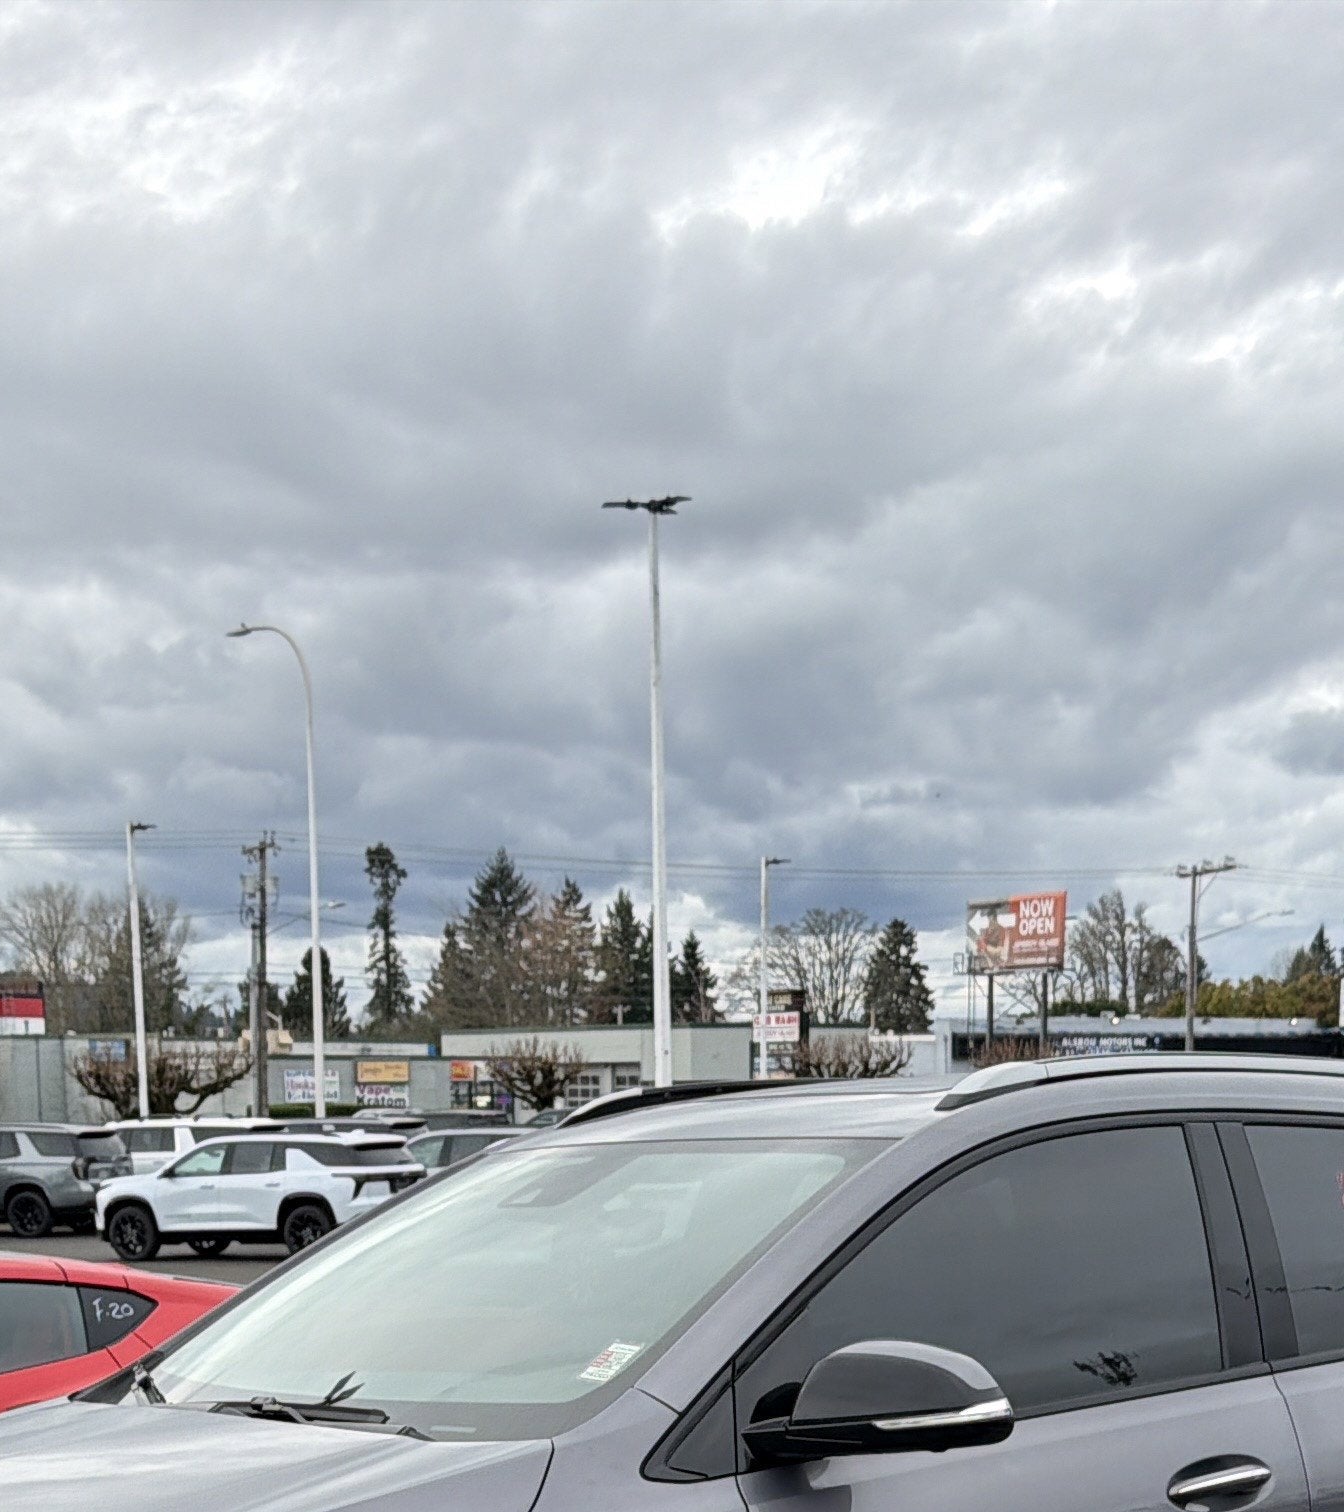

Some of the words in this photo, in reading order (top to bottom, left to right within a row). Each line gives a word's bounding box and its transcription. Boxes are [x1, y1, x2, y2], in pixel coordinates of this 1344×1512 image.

[1019, 898, 1055, 918] NOW
[1018, 916, 1055, 936] OPEN
[357, 1084, 391, 1096] Vape
[357, 1094, 407, 1108] Kratom
